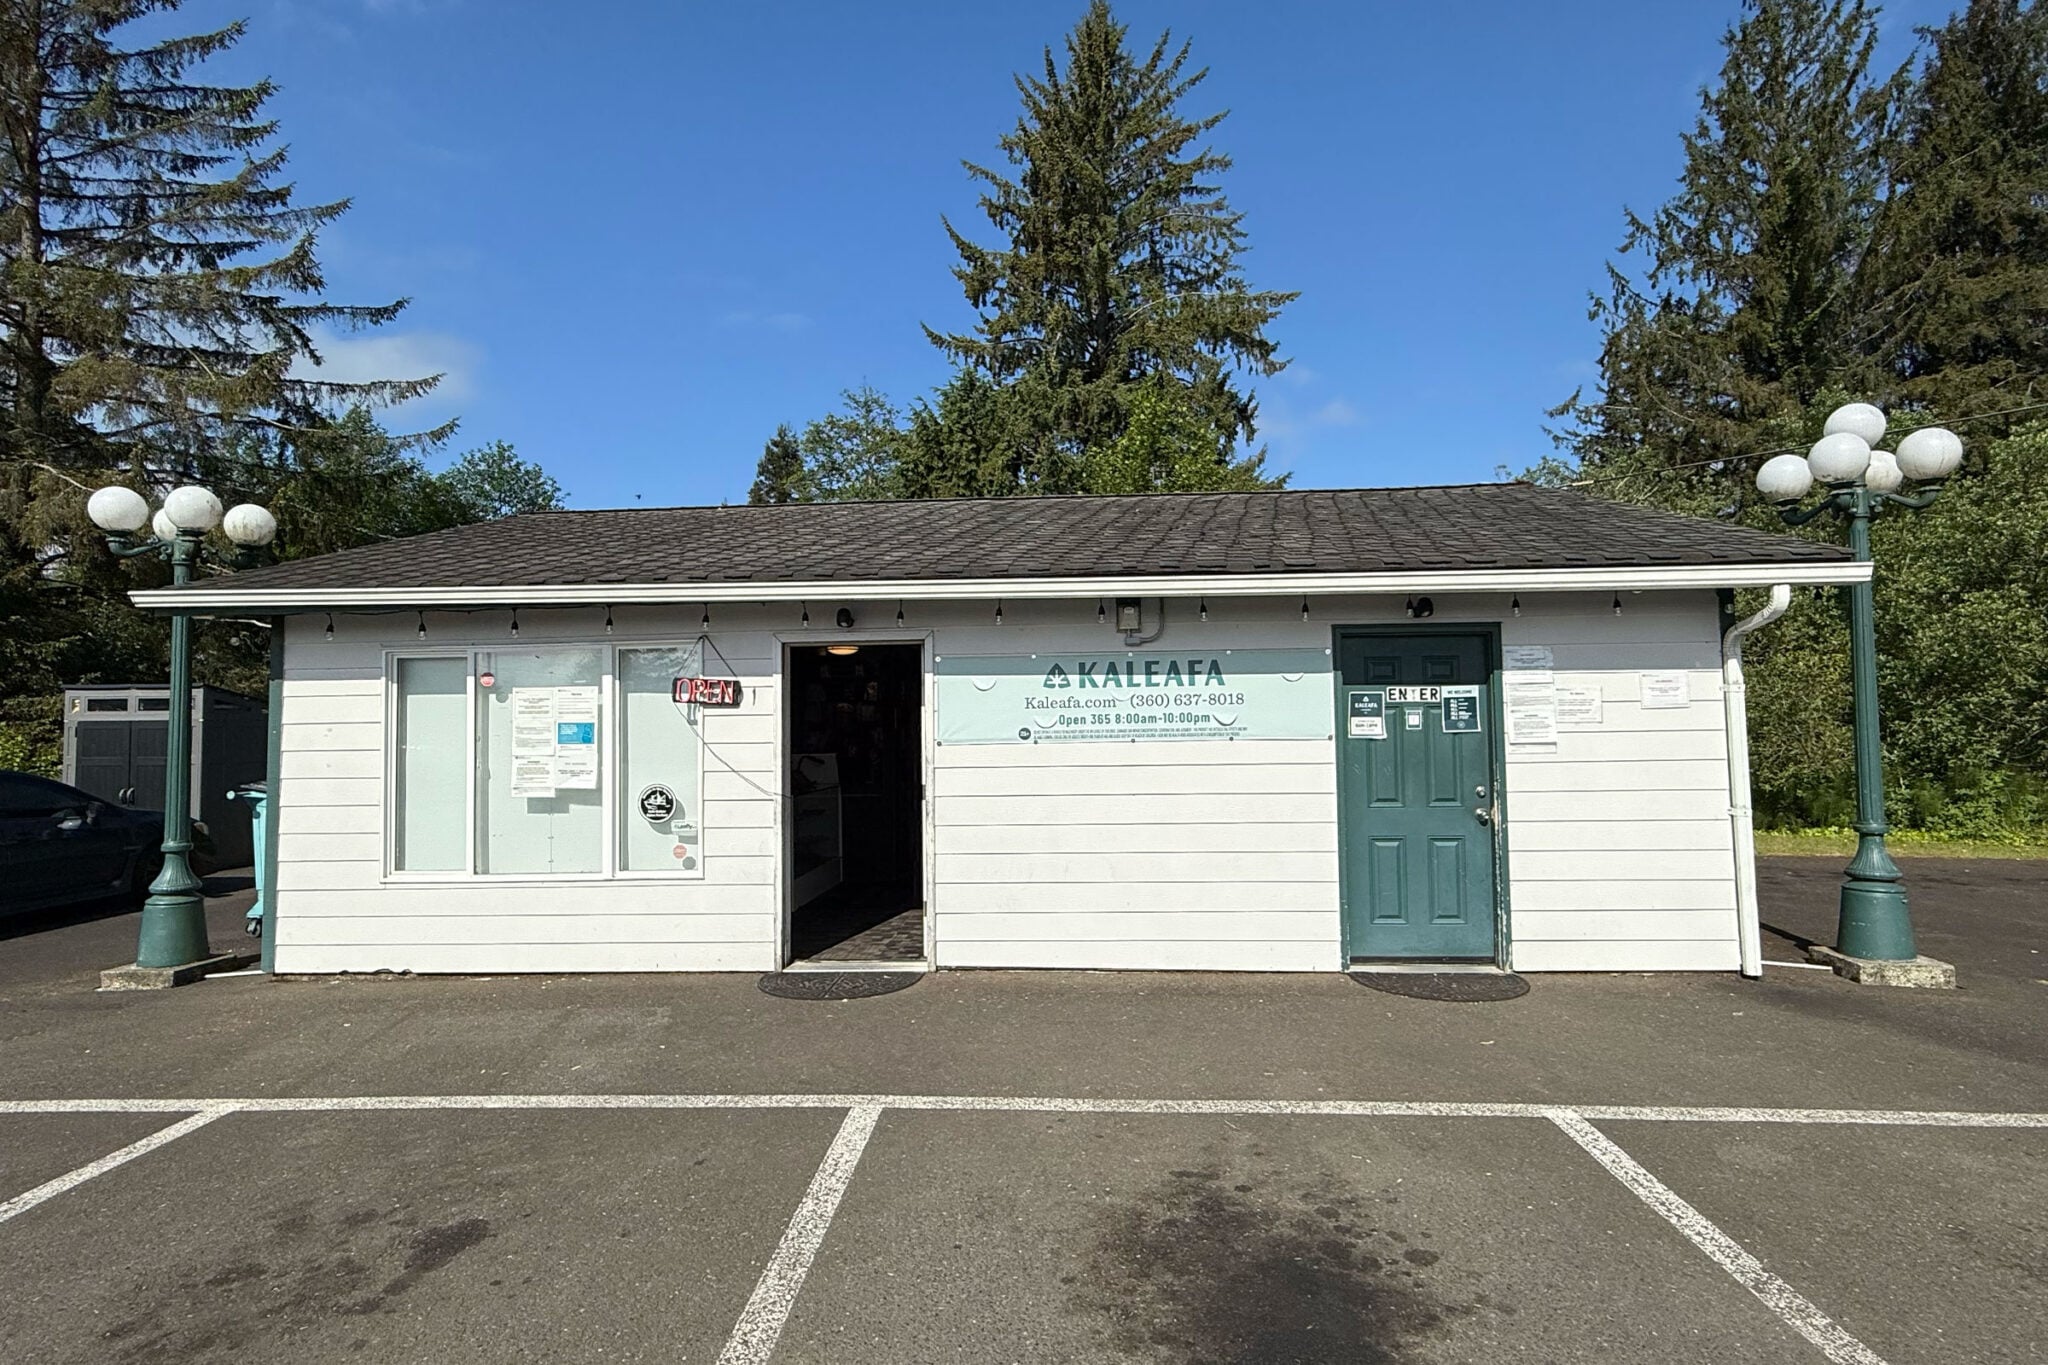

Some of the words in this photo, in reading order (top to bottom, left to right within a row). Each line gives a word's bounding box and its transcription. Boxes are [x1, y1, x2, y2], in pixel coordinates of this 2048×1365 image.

[1078, 659, 1226, 689] KALEAFA
[675, 678, 734, 704] OPEN
[1388, 688, 1439, 701] ENTER
[1024, 695, 1117, 710] Kaleafa.com
[1130, 693, 1170, 709] (360)
[1174, 692, 1245, 706] 637-8018
[1058, 714, 1087, 727] Open
[1090, 713, 1111, 725] 365
[1115, 711, 1211, 726] 8:00am-10:00pm
